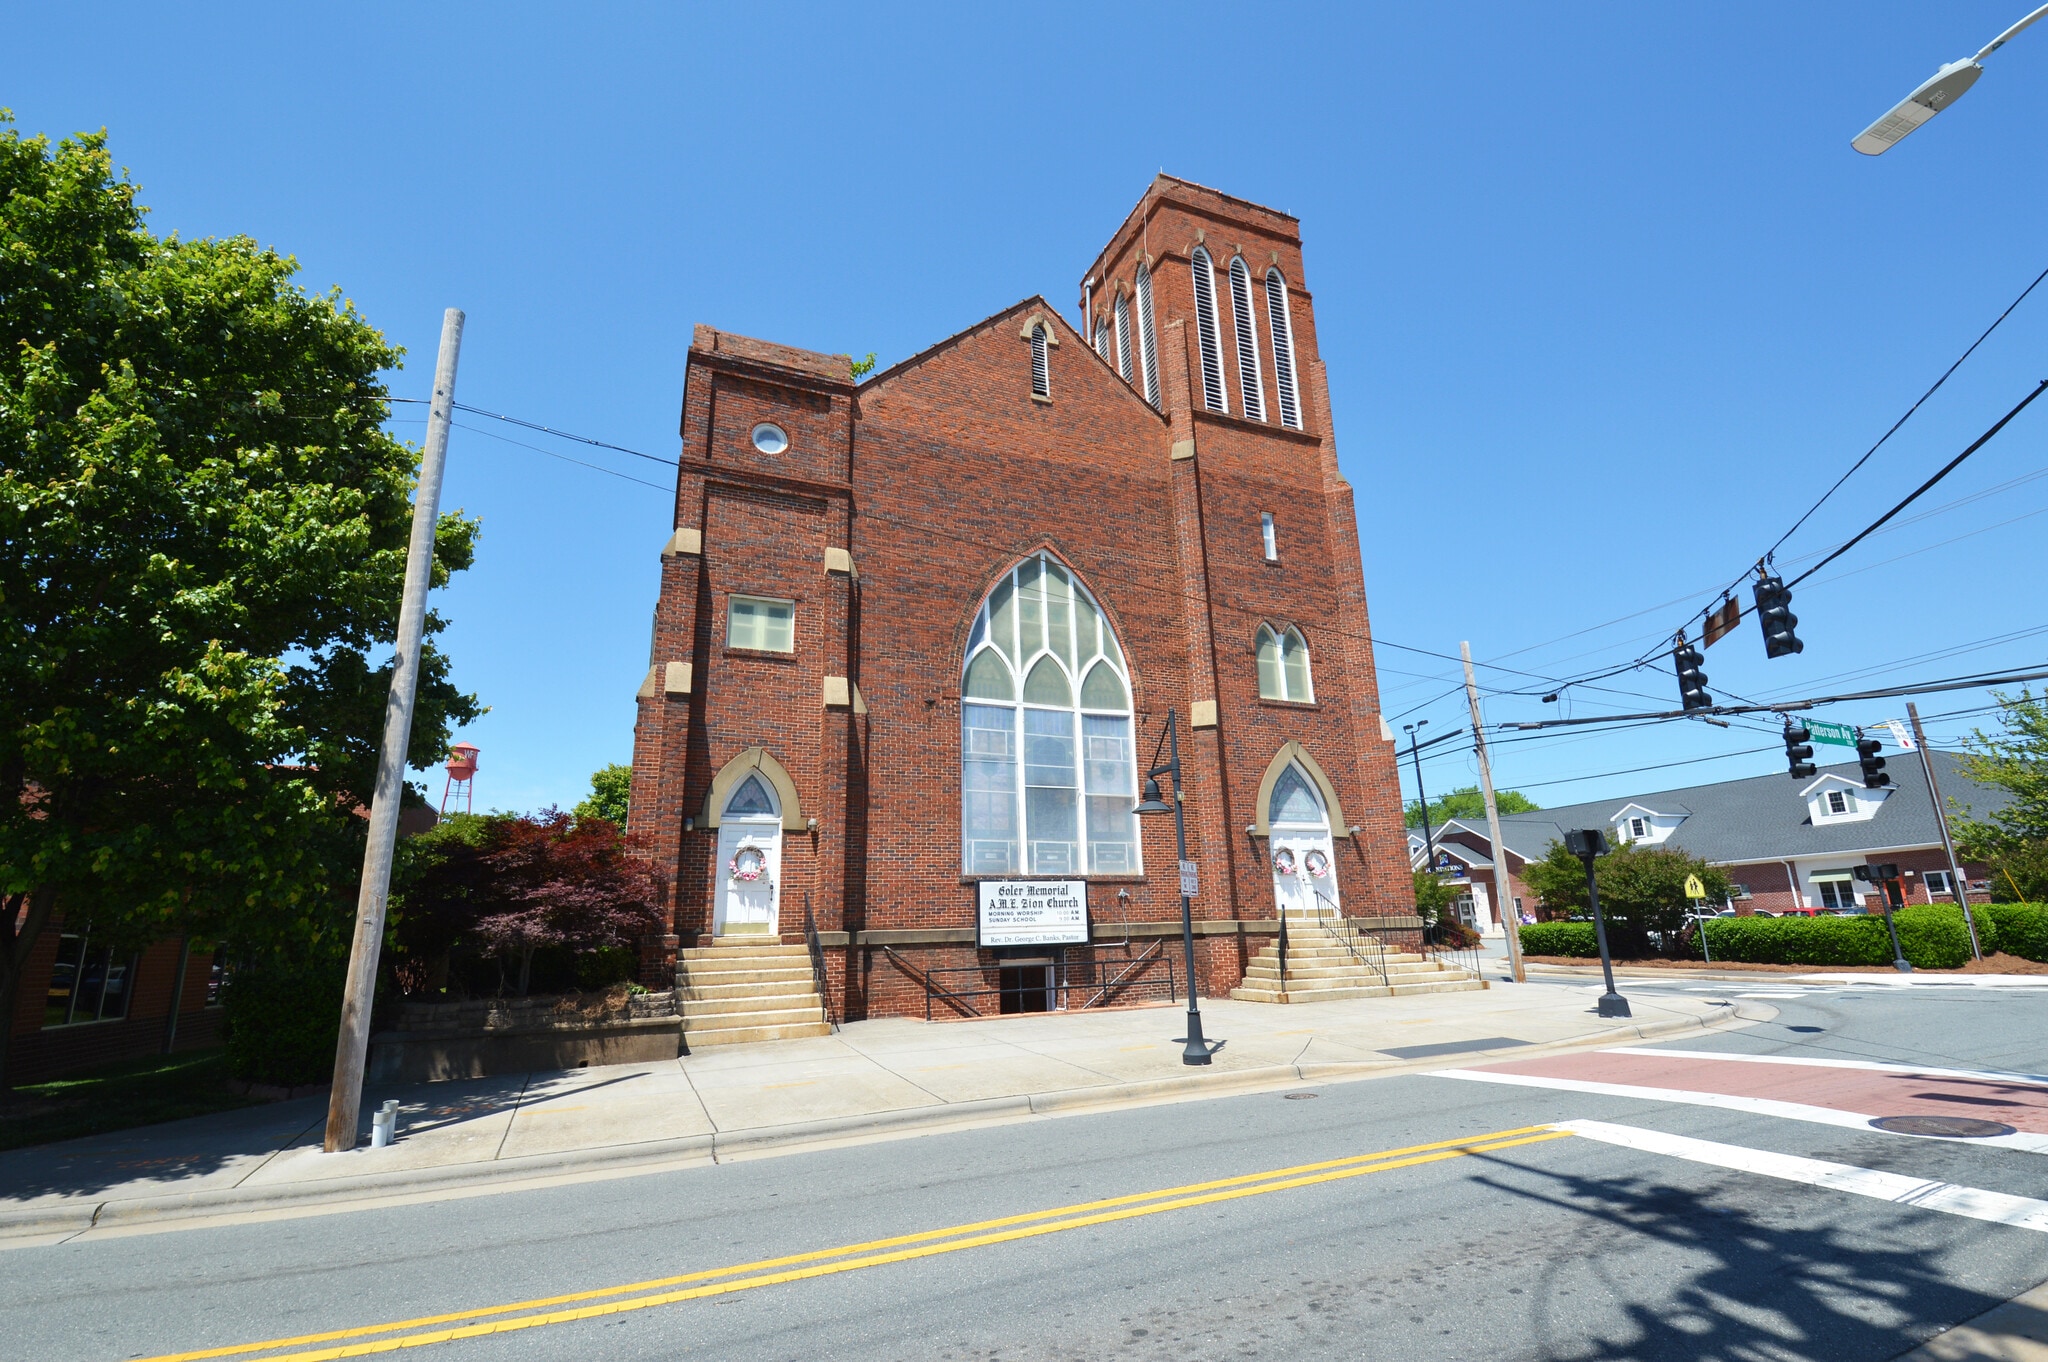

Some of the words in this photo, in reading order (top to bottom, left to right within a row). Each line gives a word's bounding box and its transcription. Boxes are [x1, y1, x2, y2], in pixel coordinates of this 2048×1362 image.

[998, 884, 1023, 896] Goler
[1027, 884, 1068, 896] Memorial
[989, 898, 1018, 909] A.M.E.
[1021, 898, 1043, 909] Zion
[1046, 896, 1079, 908] Church
[1014, 935, 1035, 944] George
